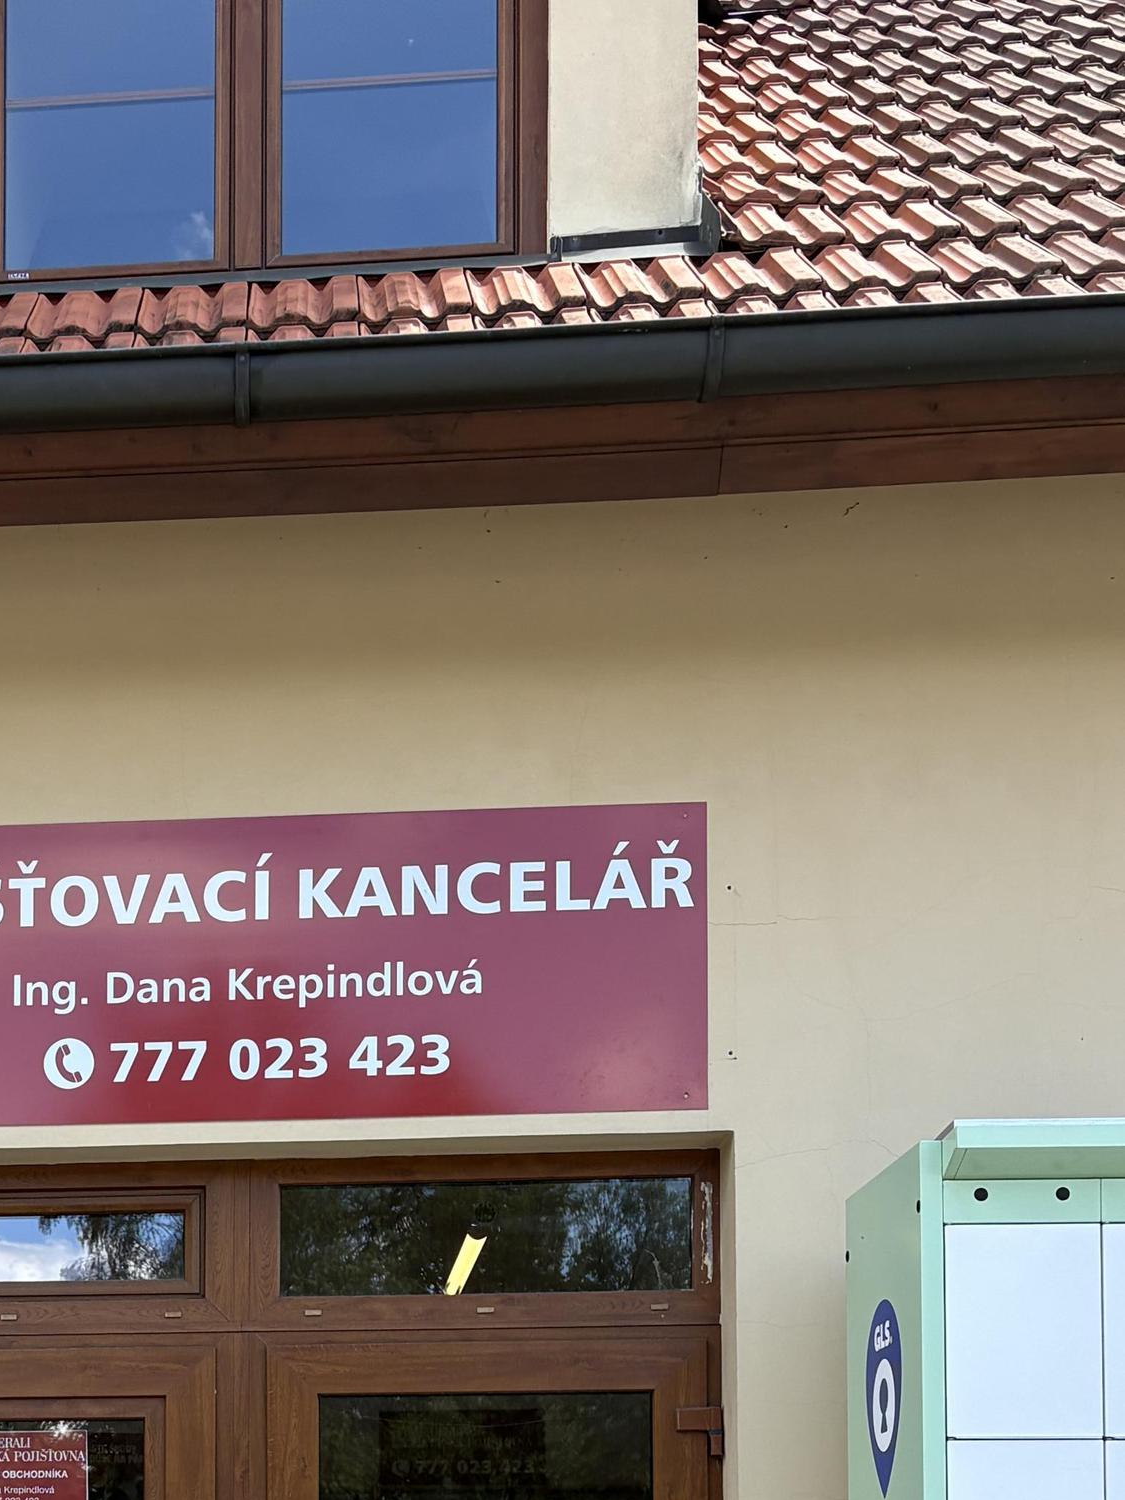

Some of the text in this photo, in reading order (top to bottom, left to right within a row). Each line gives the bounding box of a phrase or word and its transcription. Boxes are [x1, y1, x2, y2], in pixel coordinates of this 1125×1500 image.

[299, 840, 694, 918] KANCELÁŘ
[14, 959, 481, 1014] Ing. Dana Krepindlová
[111, 1034, 449, 1082] 777 023 423
[14, 1449, 85, 1462] POJIŠŤOVNA
[2, 1468, 68, 1478] OBCHODNÍKA
[4, 1486, 54, 1496] Krepindlová
